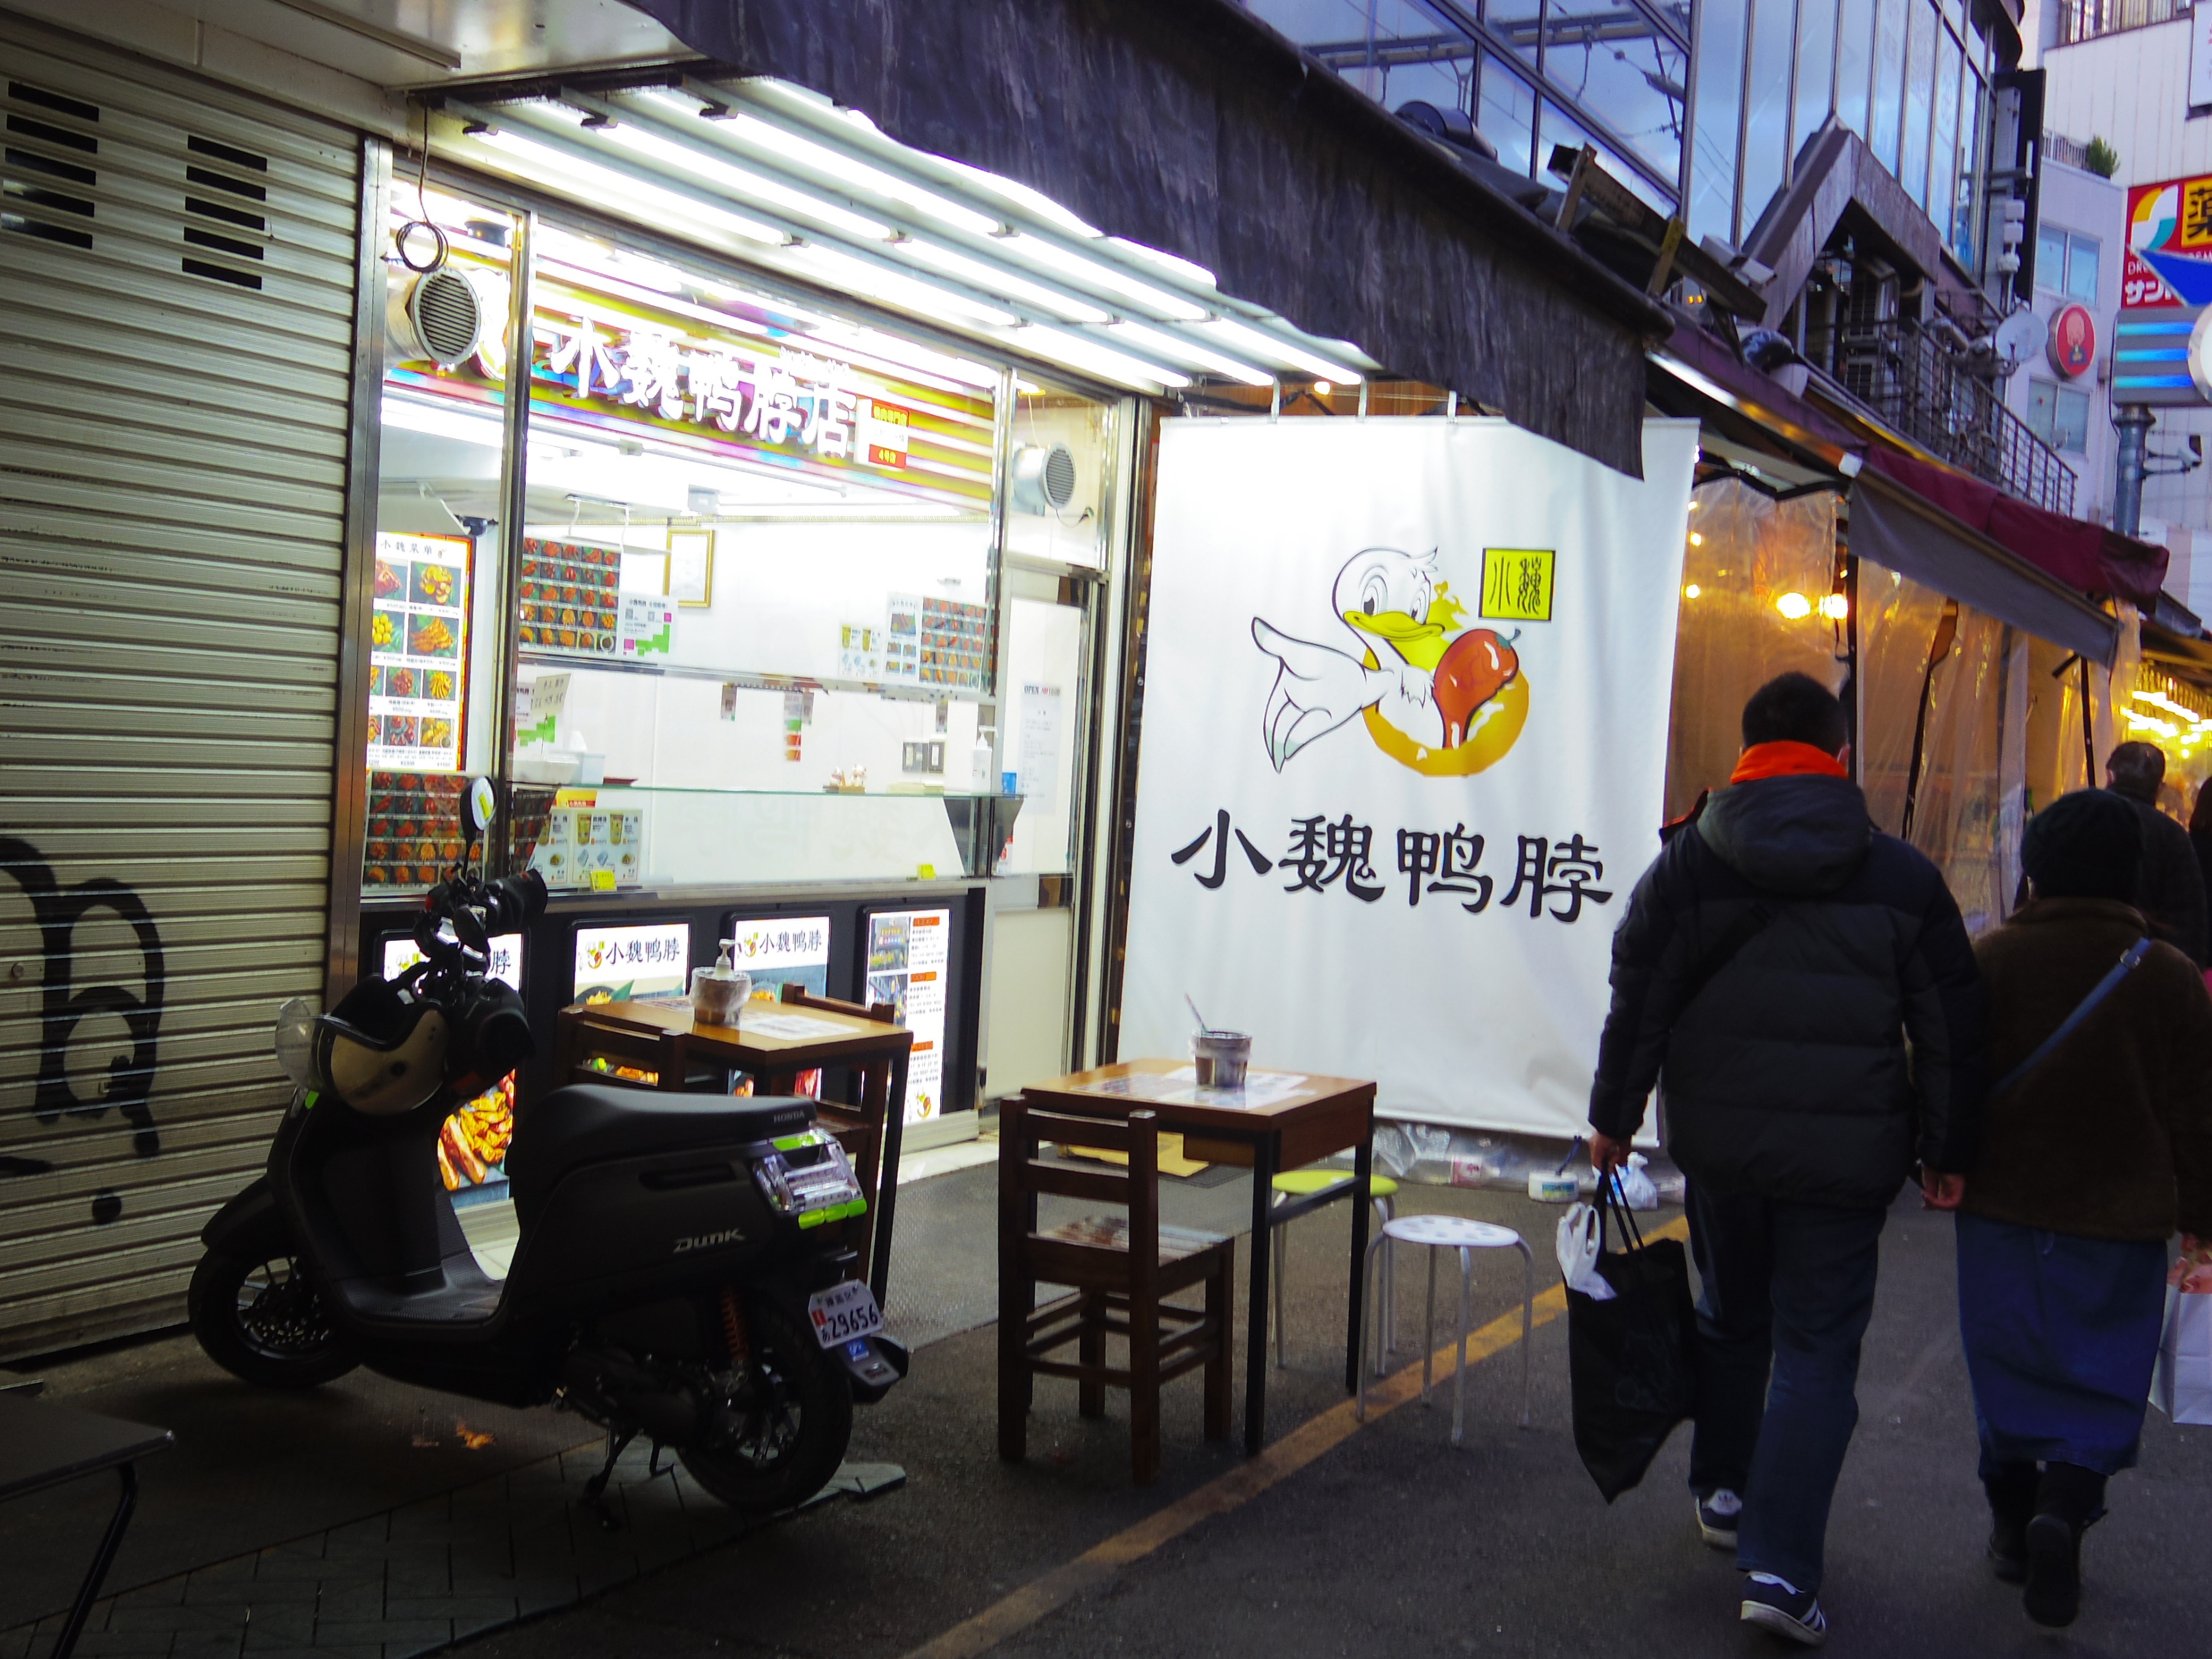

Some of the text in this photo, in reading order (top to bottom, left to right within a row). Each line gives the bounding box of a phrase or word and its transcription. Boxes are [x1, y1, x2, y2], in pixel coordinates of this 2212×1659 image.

[1170, 808, 1614, 924] 小魏鸭脖
[605, 935, 680, 966] 小魏鸭脖
[759, 928, 822, 955] 小魏鸭脖
[773, 1110, 805, 1124] HONDA
[828, 1303, 878, 1339] 29656
